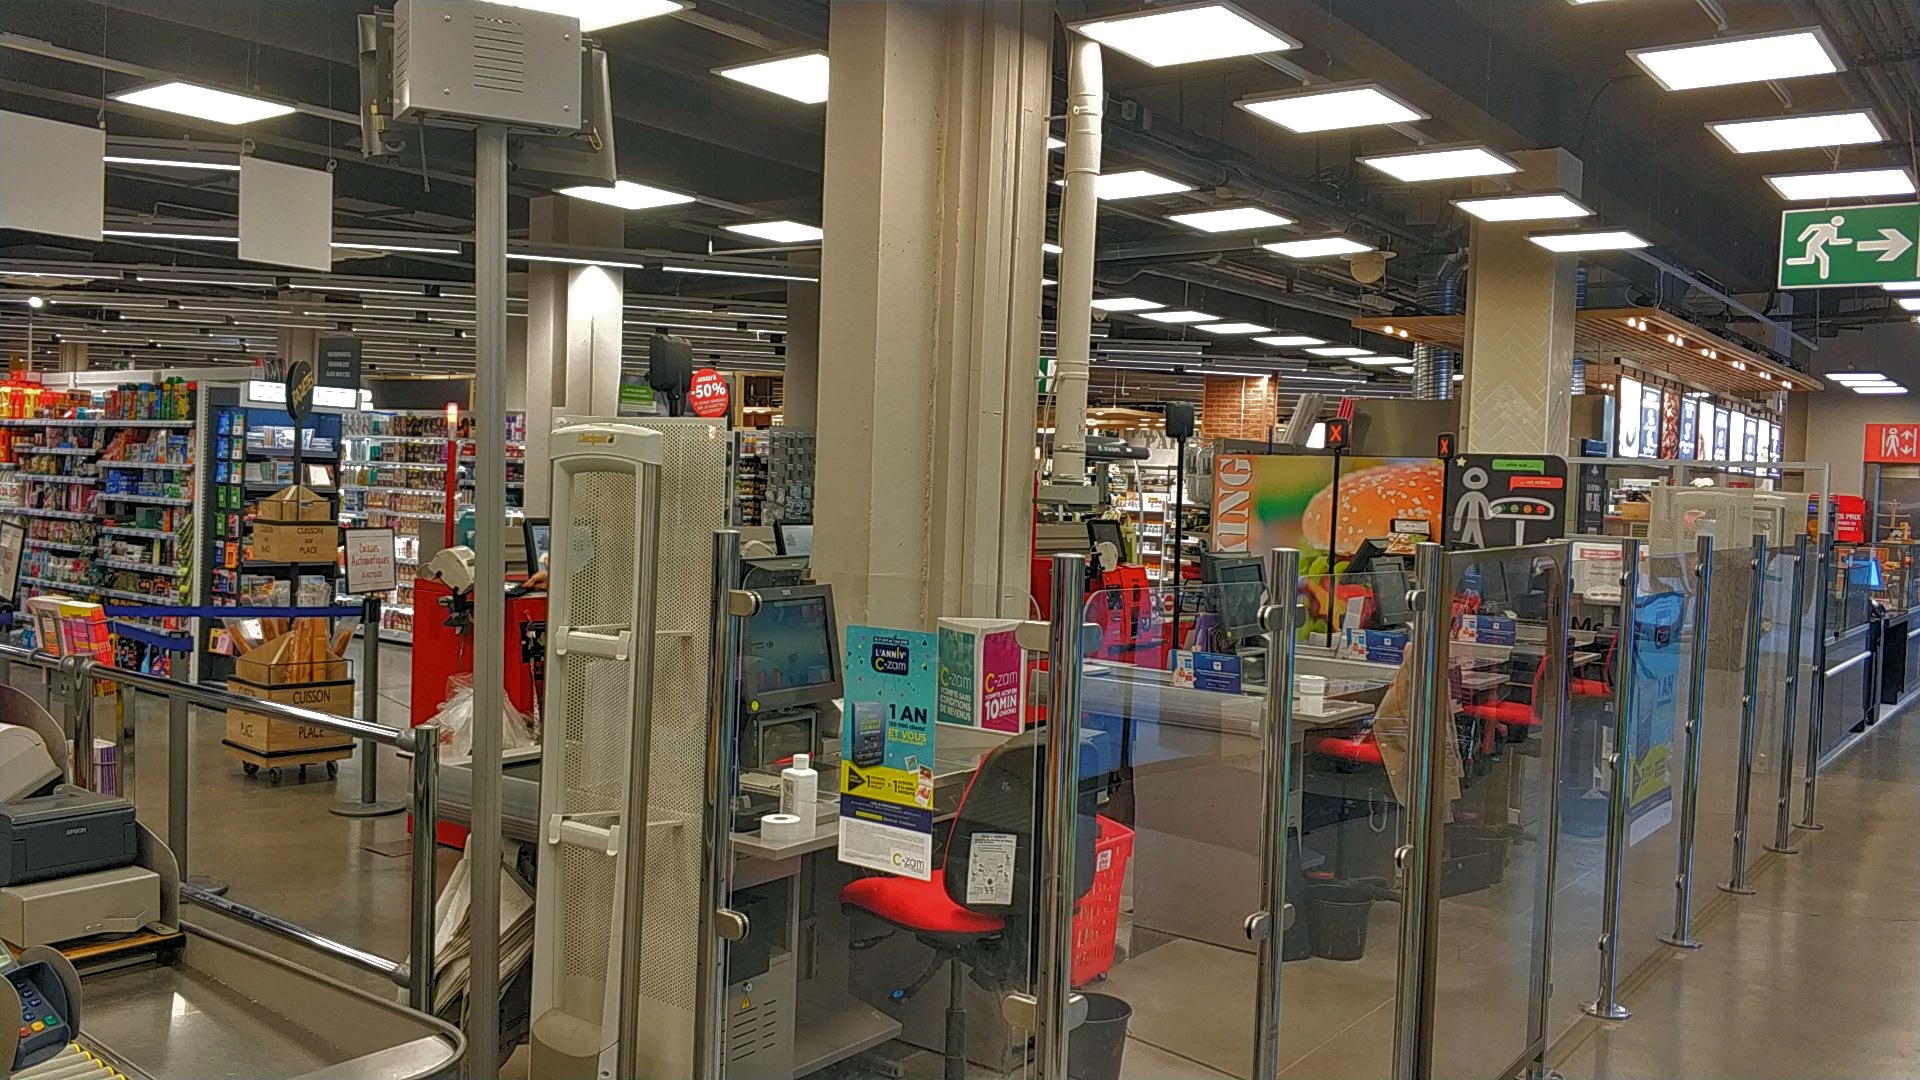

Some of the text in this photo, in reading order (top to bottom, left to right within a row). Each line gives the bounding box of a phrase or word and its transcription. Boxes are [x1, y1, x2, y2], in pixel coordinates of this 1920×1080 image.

[691, 382, 726, 399] -50%
[299, 546, 318, 554] PLACE
[875, 646, 907, 660] L'ANNIV'
[875, 657, 907, 671] C-zam
[941, 667, 972, 690] C-zam
[985, 671, 1018, 693] C-zam
[293, 689, 331, 705] CUISSON
[941, 694, 972, 712] CONDITIONS
[889, 703, 928, 725] 1 AN
[947, 706, 972, 722] REVENUS
[985, 694, 1018, 721] 10 MIN
[999, 707, 1017, 718] CHRONO
[299, 726, 325, 740] PLACE
[888, 728, 927, 742] ET VOUS
[892, 852, 925, 870] C-zam
